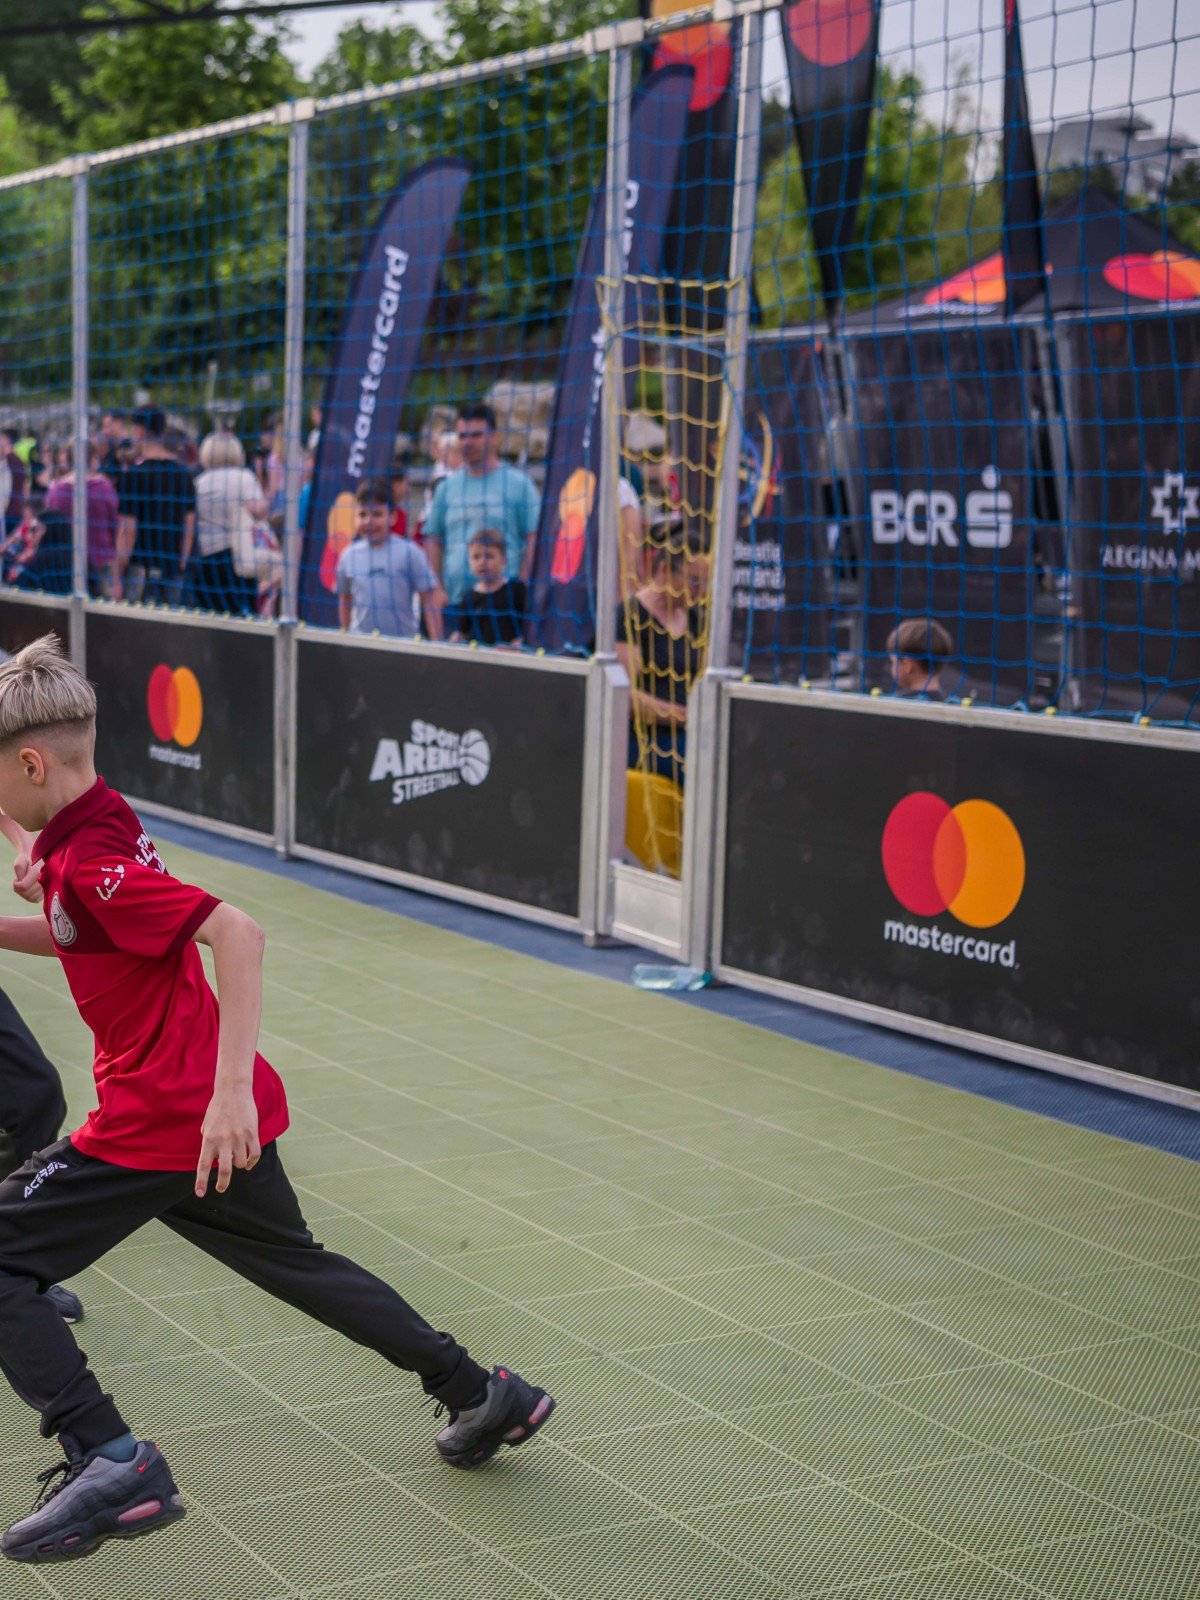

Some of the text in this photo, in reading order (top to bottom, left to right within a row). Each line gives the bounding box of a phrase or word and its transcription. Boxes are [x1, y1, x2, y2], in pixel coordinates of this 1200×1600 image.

[347, 244, 409, 478] mastercard
[870, 489, 960, 547] BCR
[883, 919, 1017, 969] mastercard
